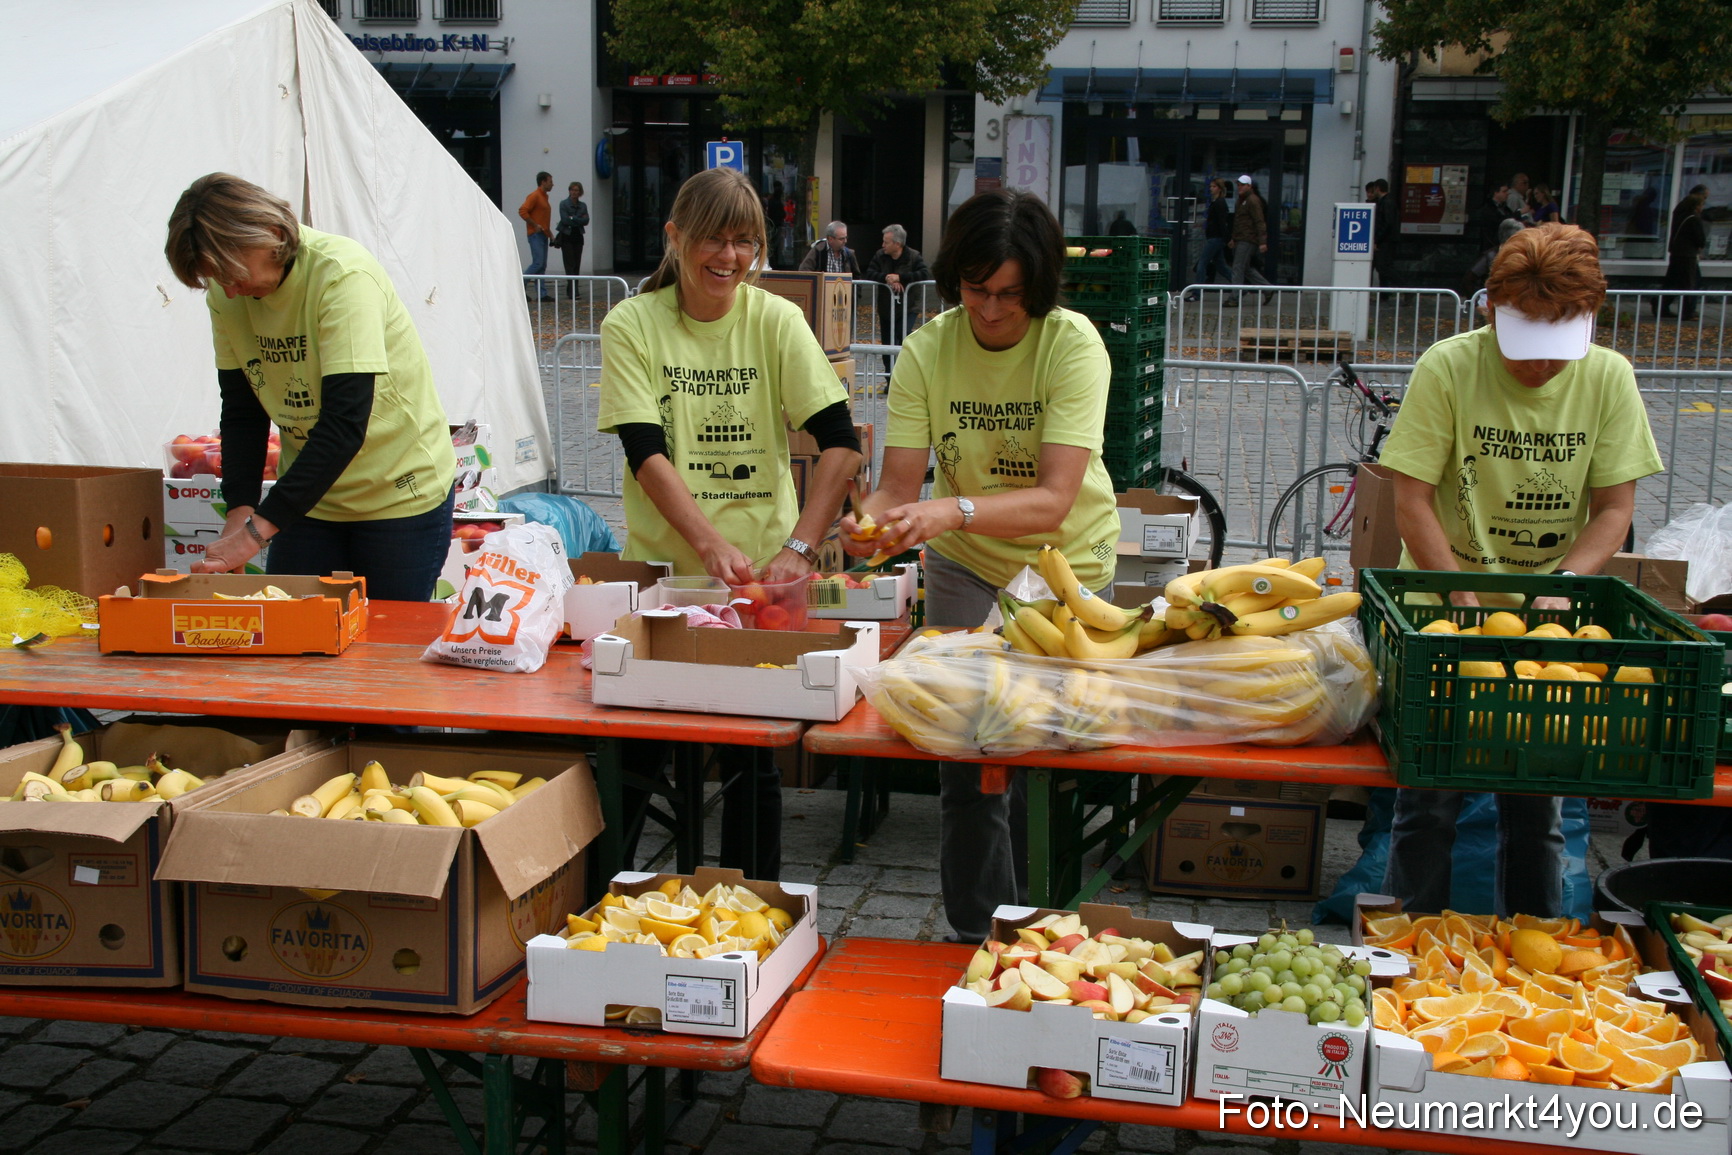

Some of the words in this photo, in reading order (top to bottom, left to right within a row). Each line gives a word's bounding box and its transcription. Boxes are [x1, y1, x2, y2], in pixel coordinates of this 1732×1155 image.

[442, 33, 488, 51] K+N
[987, 118, 1000, 141] 3
[715, 146, 735, 168] P
[1343, 211, 1368, 220] HIER
[1348, 221, 1361, 240] P
[1340, 242, 1367, 252] SCHEINE
[663, 365, 758, 382] NEUMARKTER
[670, 380, 751, 396] STADTLAUF
[950, 401, 1043, 417] NEUMARKTER
[958, 416, 1036, 431] STADTLAUF
[1473, 425, 1587, 447] NEUMARKTER
[688, 448, 767, 457] www.stadtlauf-neumarkt.de
[1480, 442, 1577, 462] STADTLAUF
[702, 491, 773, 500] Stadtlaufteam
[1450, 544, 1478, 564] Danke
[463, 587, 511, 622] M
[174, 615, 262, 632] EDEKA
[188, 632, 252, 650] Backstube
[451, 645, 477, 655] Unsere
[478, 646, 502, 656] Preise
[461, 656, 472, 664] Sie
[473, 657, 516, 667] vergleichen!
[1206, 855, 1263, 867] FAVORITA
[0, 913, 69, 930] VORITA
[271, 928, 366, 951] FAVORITA
[19, 967, 32, 975] OF
[34, 967, 78, 976] ECUADOR
[268, 982, 311, 994] PRODUCT
[312, 986, 326, 995] OF
[327, 988, 372, 999] ECUADOR
[1216, 1022, 1236, 1031] ITALIA
